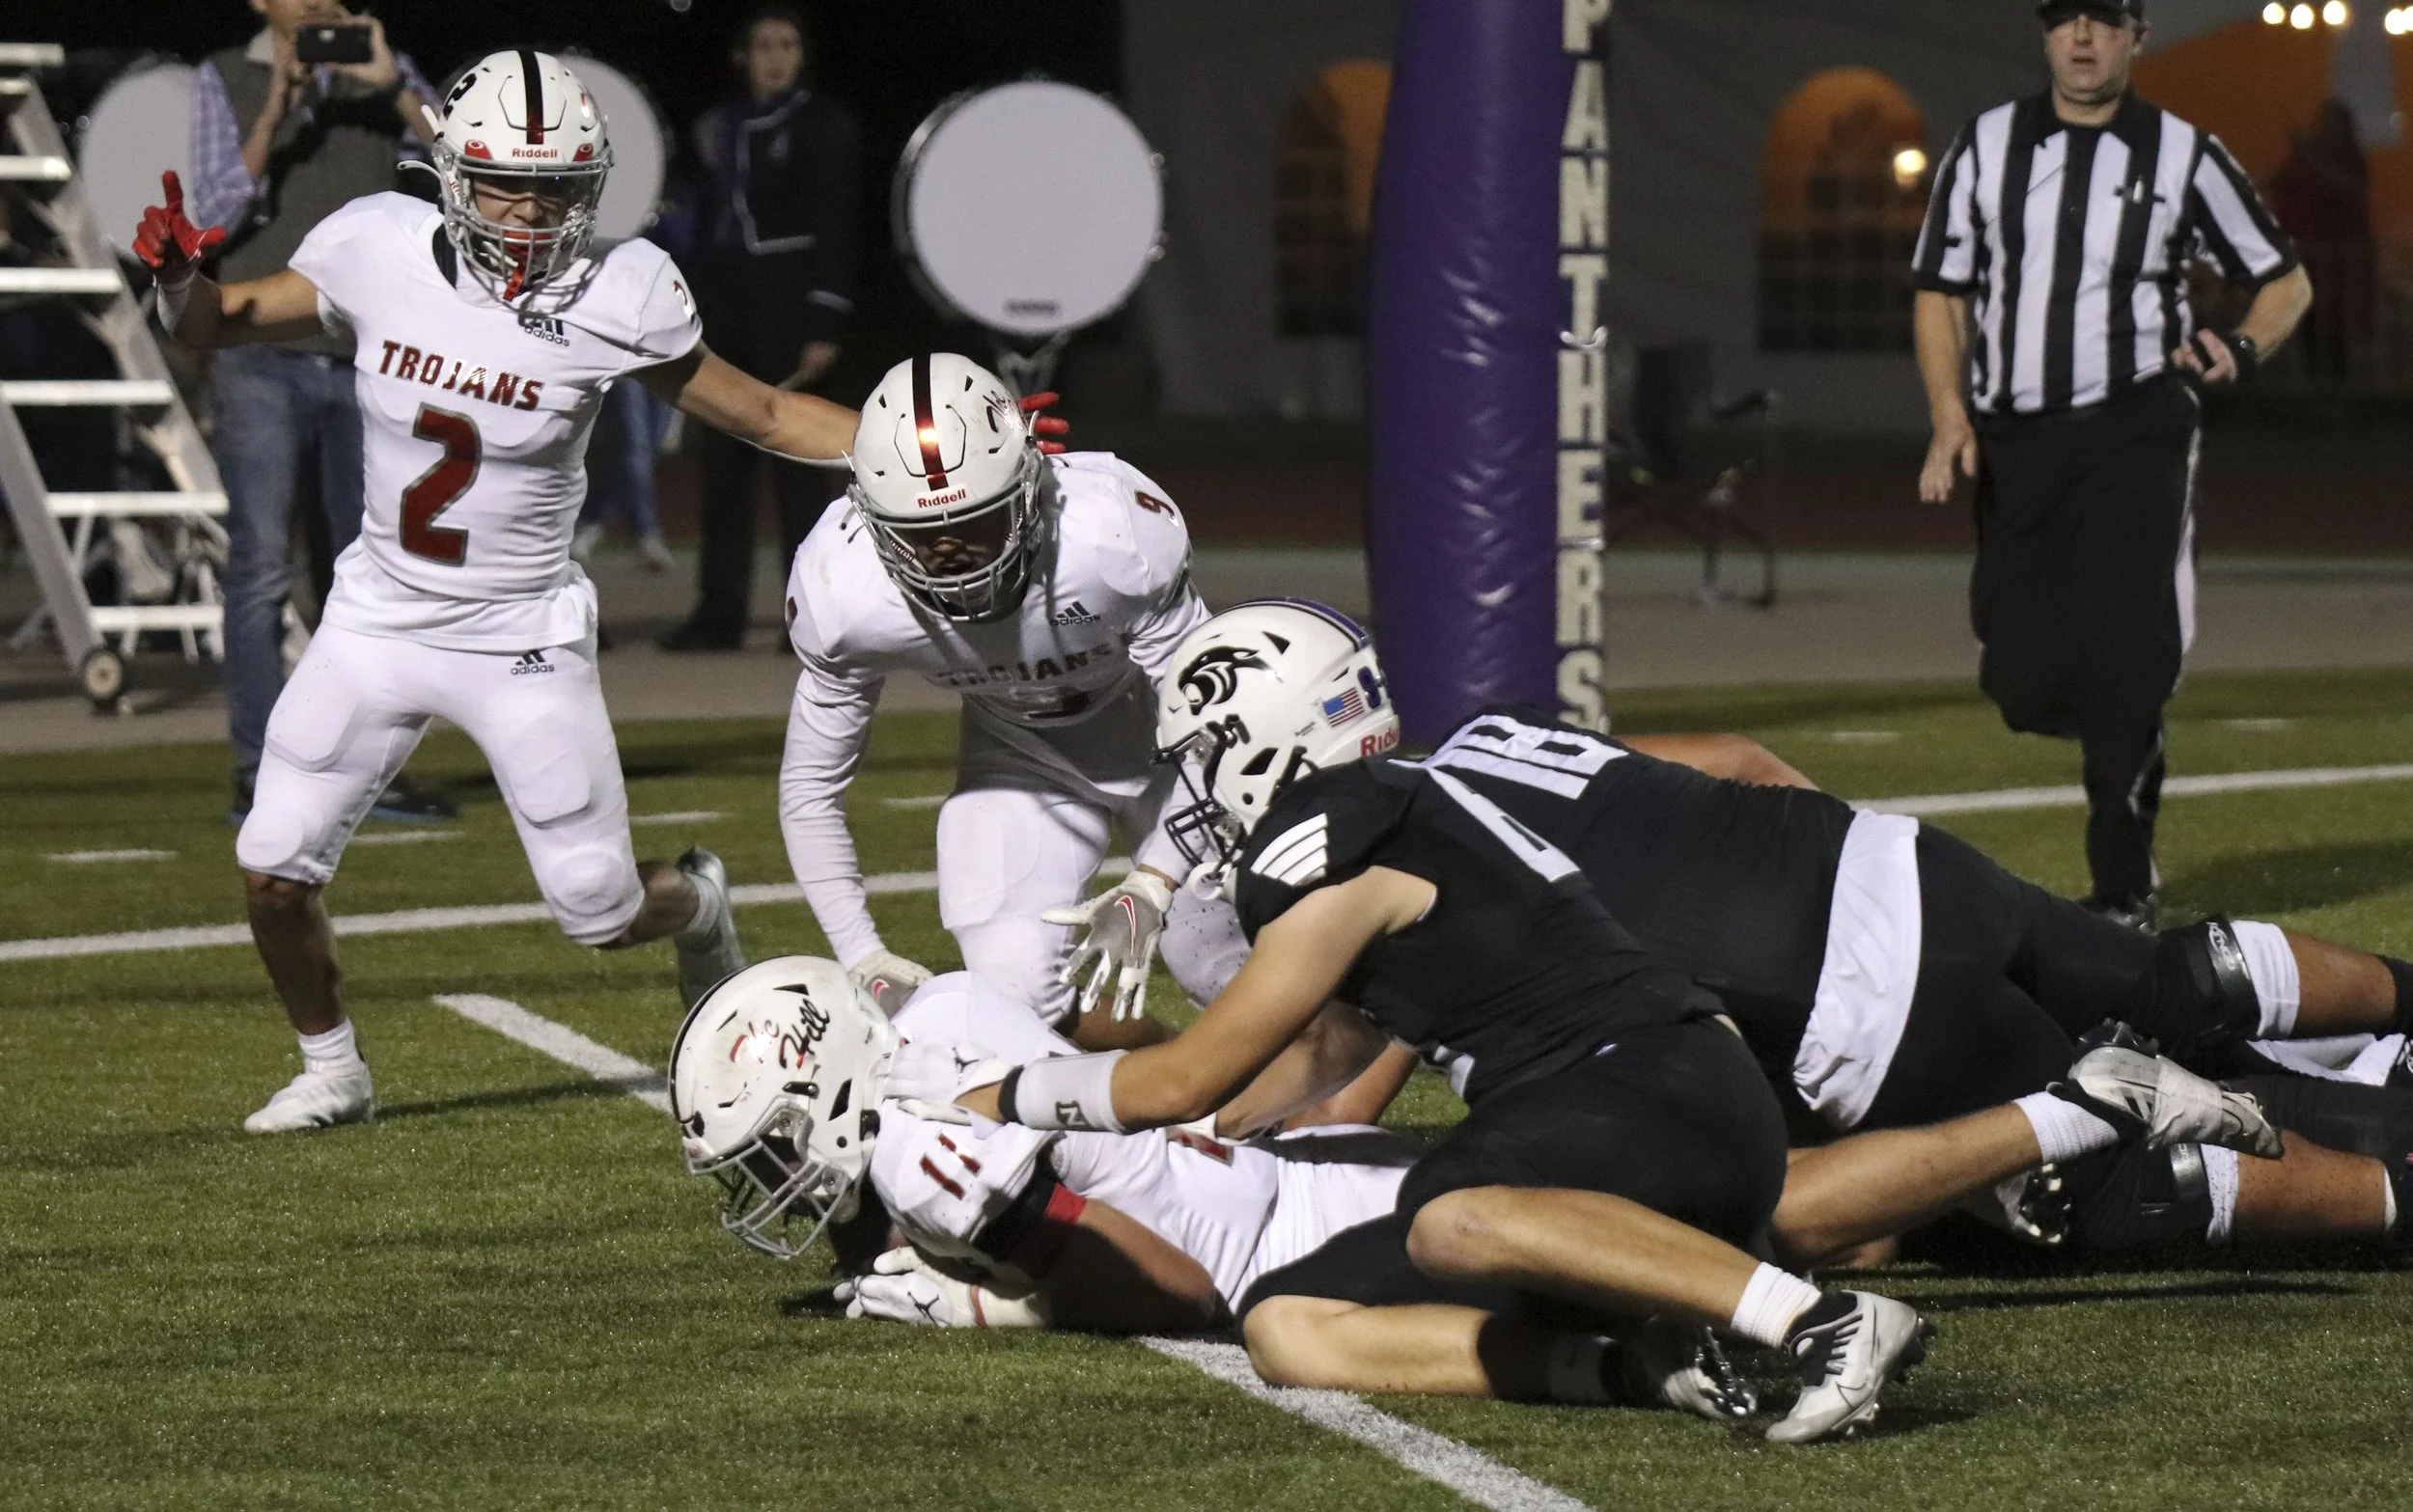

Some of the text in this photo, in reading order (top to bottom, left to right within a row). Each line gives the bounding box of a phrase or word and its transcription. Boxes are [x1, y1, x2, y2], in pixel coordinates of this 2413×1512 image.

[442, 72, 477, 120] 2
[512, 148, 558, 158] Riddell
[524, 325, 570, 347] adidas
[378, 339, 544, 412] TROJANS
[1556, 0, 1610, 731] PANTHERS
[399, 400, 483, 568] 2
[917, 488, 966, 509] Riddell
[1049, 614, 1101, 626] adidas
[510, 663, 555, 675] adidas
